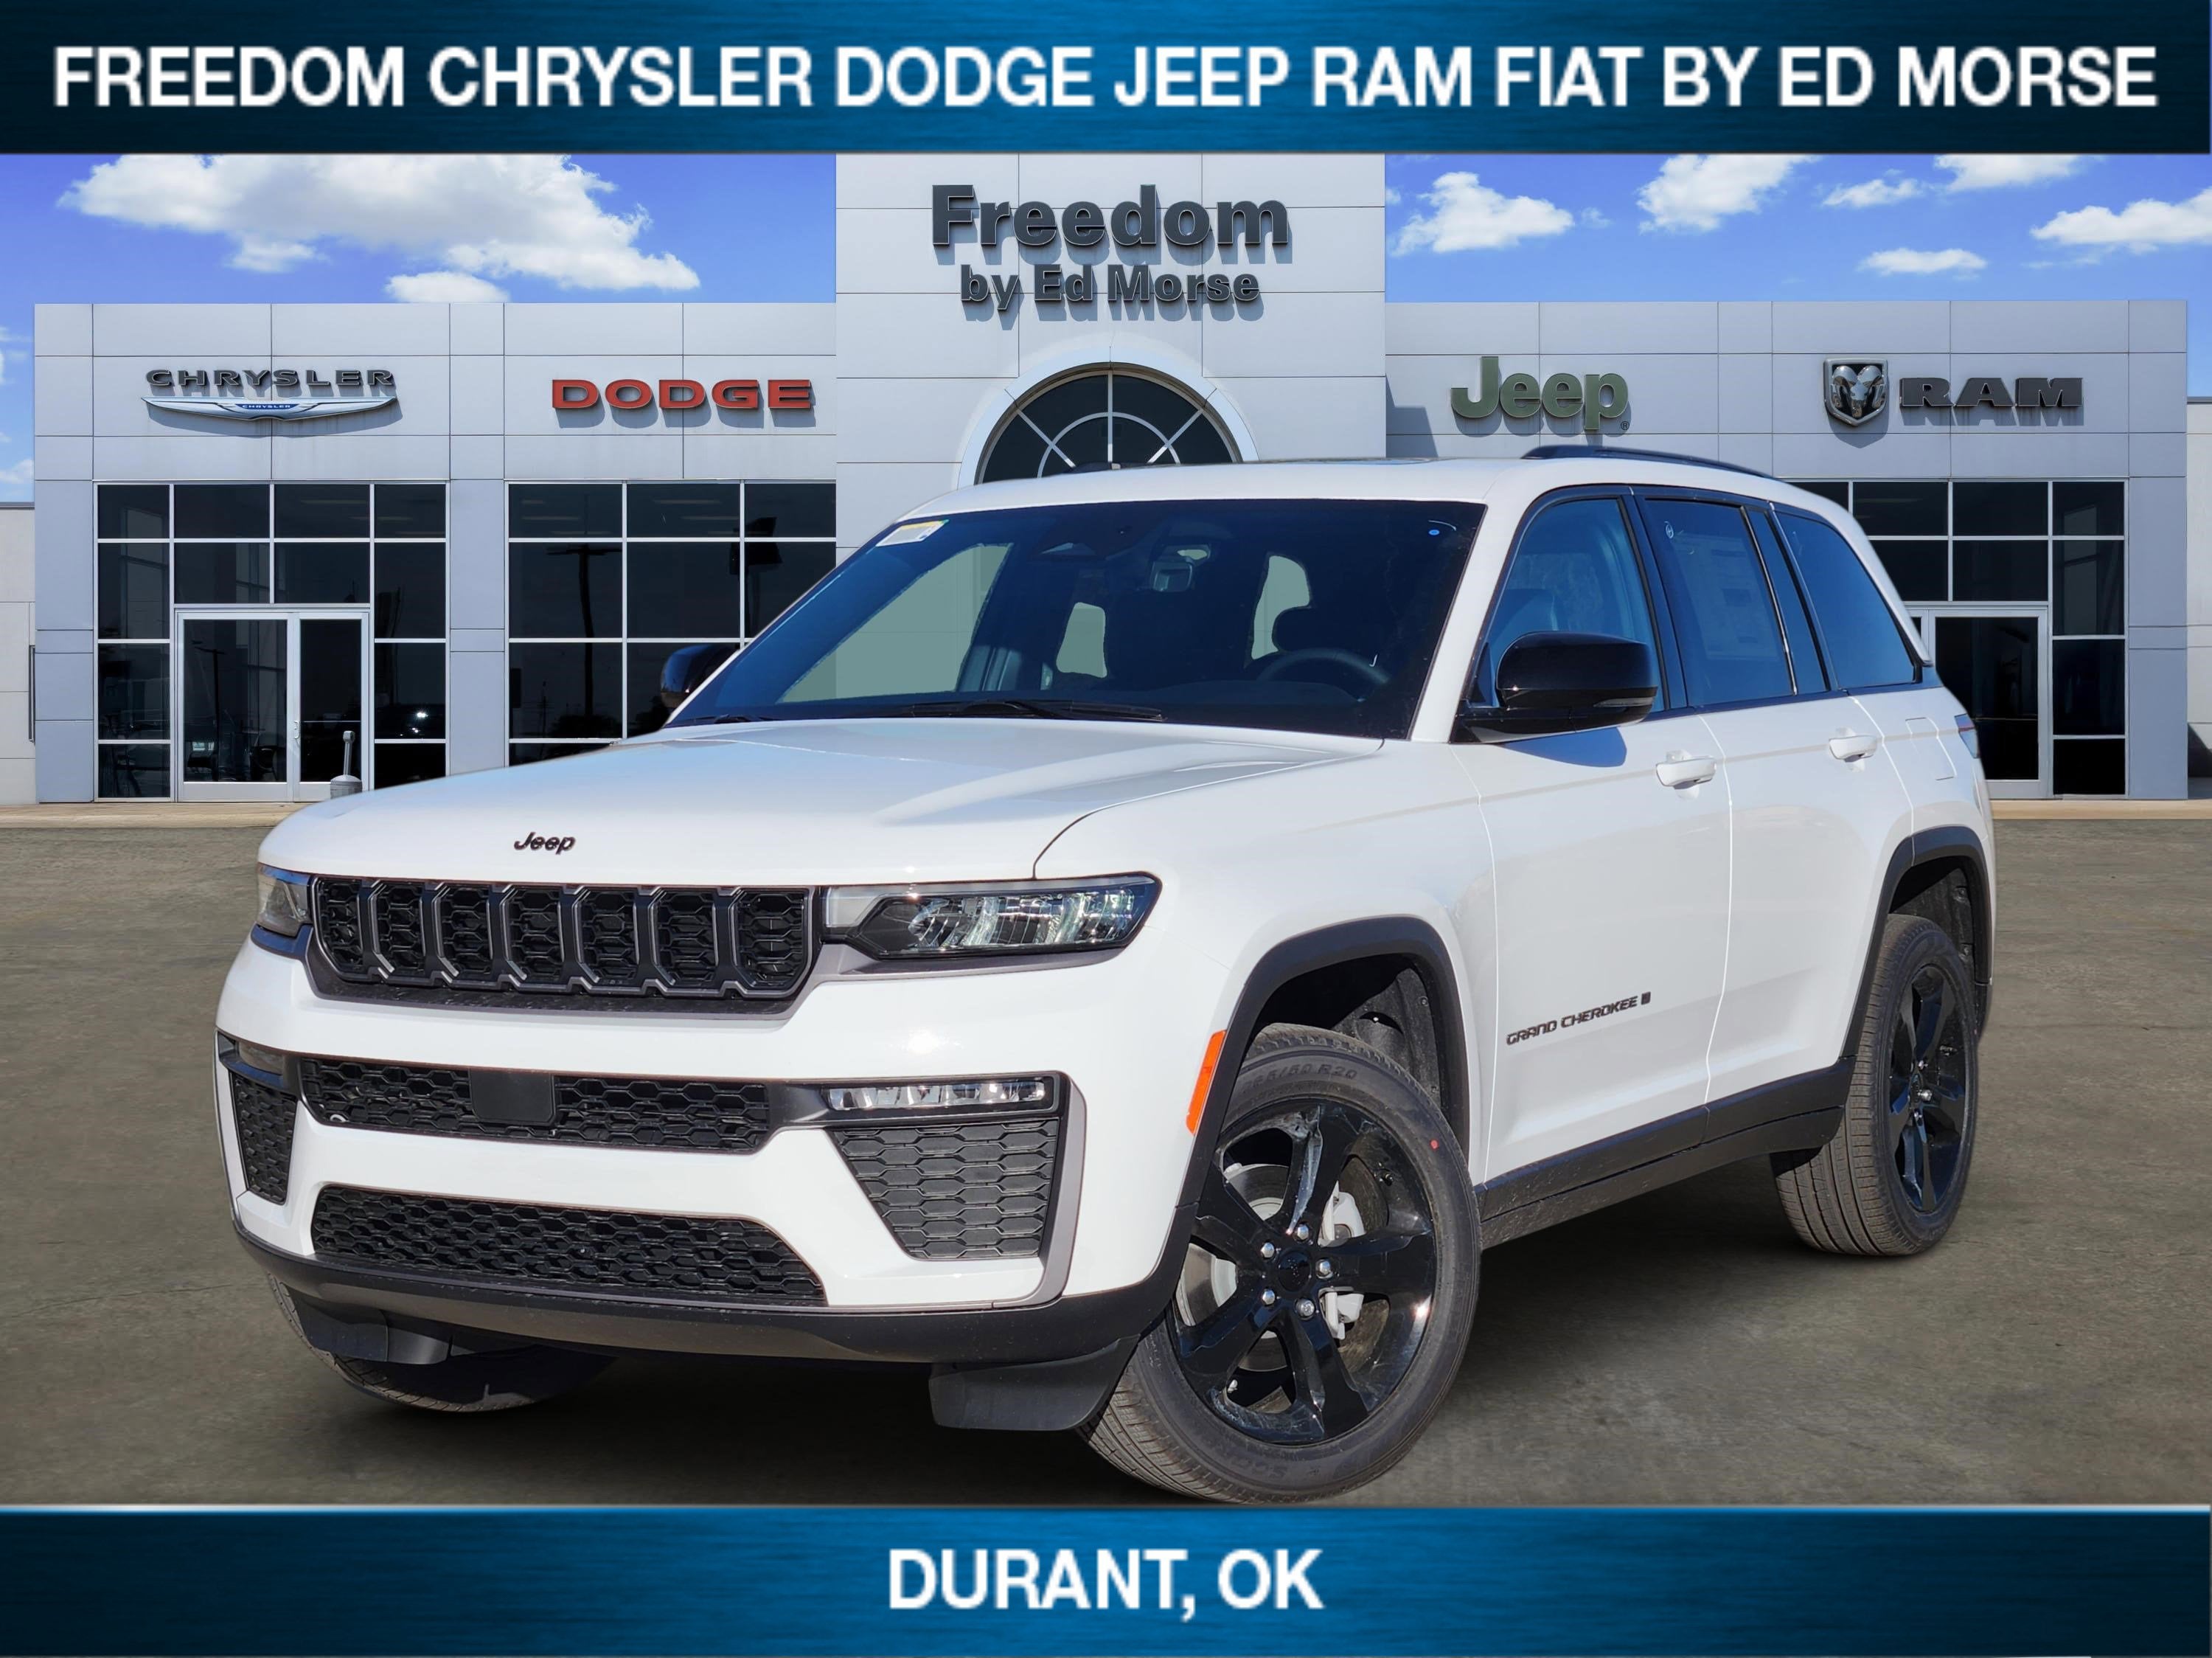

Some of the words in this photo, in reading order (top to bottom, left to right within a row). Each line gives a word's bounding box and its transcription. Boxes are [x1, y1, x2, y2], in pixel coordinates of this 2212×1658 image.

[931, 184, 1289, 246] Freedom
[960, 263, 1019, 311] by
[1033, 263, 1094, 302] Ed
[1107, 263, 1261, 302] Morse
[145, 369, 395, 387] CHRYSLER
[552, 378, 812, 409] DODGE
[1450, 355, 1629, 431] Jeep
[1898, 376, 2085, 408] RAM
[513, 830, 577, 856] Jeep
[1506, 1019, 1558, 1046] GRAND
[1560, 995, 1639, 1029] CHEROKEE
